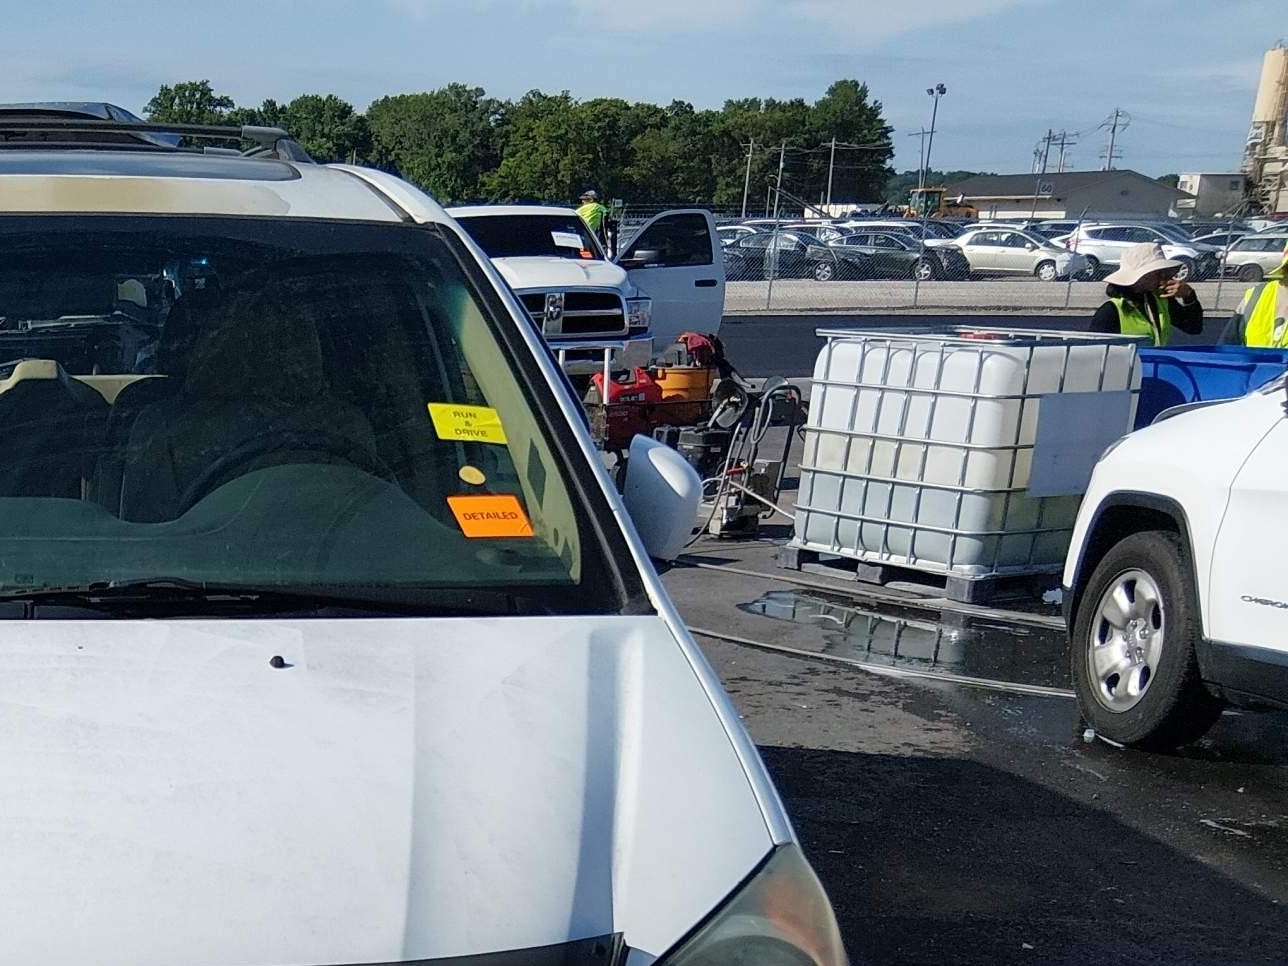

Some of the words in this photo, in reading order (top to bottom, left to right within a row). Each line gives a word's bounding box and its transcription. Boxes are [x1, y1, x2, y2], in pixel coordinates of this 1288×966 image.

[452, 410, 478, 419] RUN
[454, 428, 488, 438] DRIVE
[463, 511, 519, 521] DETAILED
